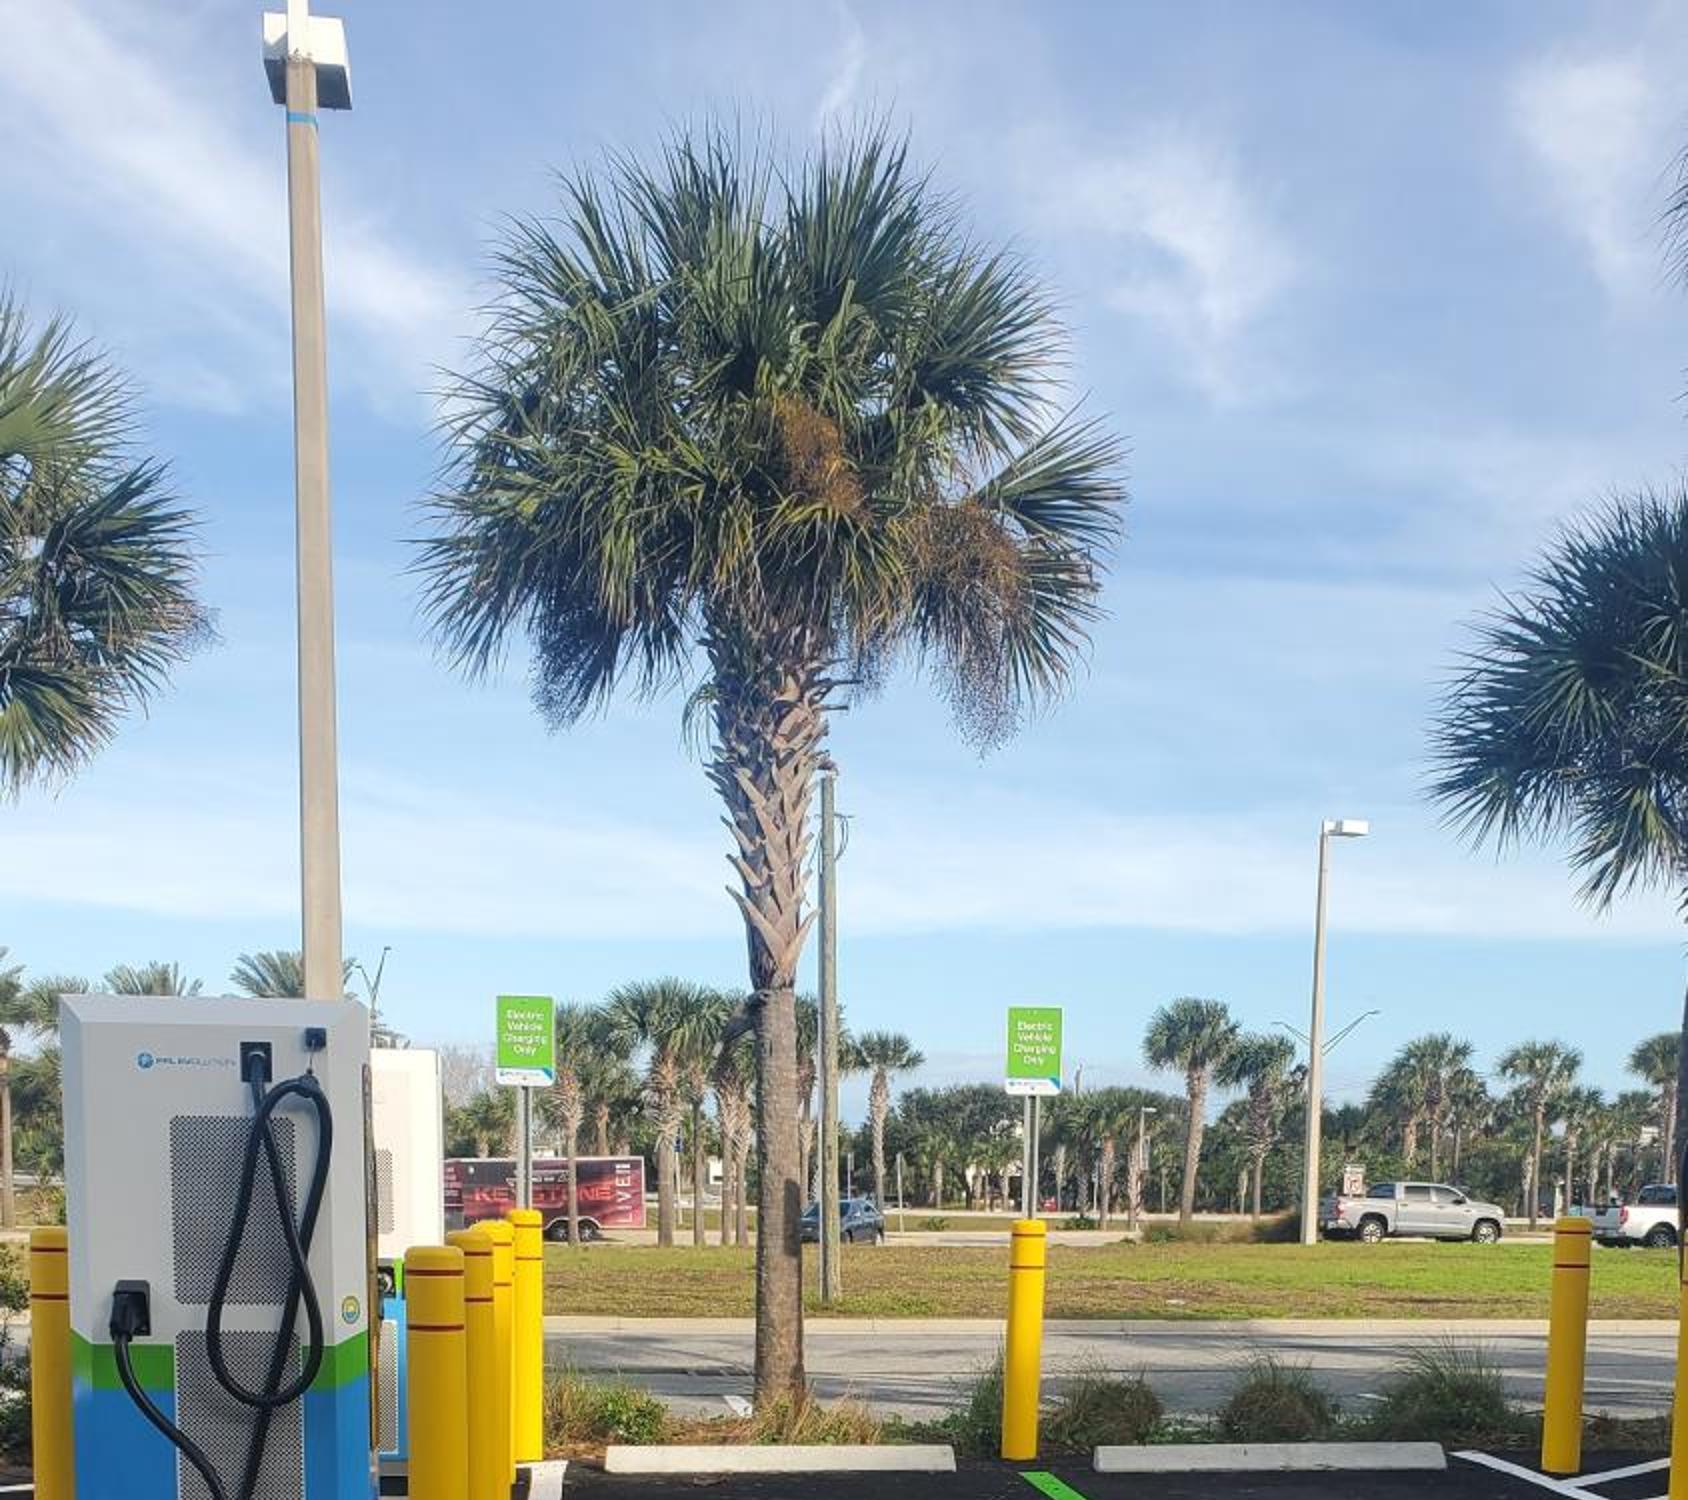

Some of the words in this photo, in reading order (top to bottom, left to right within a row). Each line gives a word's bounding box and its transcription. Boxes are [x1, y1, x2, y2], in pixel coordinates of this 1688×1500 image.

[507, 1009, 545, 1020] Electric
[507, 1021, 543, 1032] Vehicle
[1018, 1021, 1054, 1031] Electric
[506, 1033, 547, 1045] Charging
[1018, 1032, 1053, 1042] Vehicle
[513, 1045, 537, 1056] Only
[1014, 1043, 1057, 1056] Charging
[1024, 1056, 1044, 1067] Only
